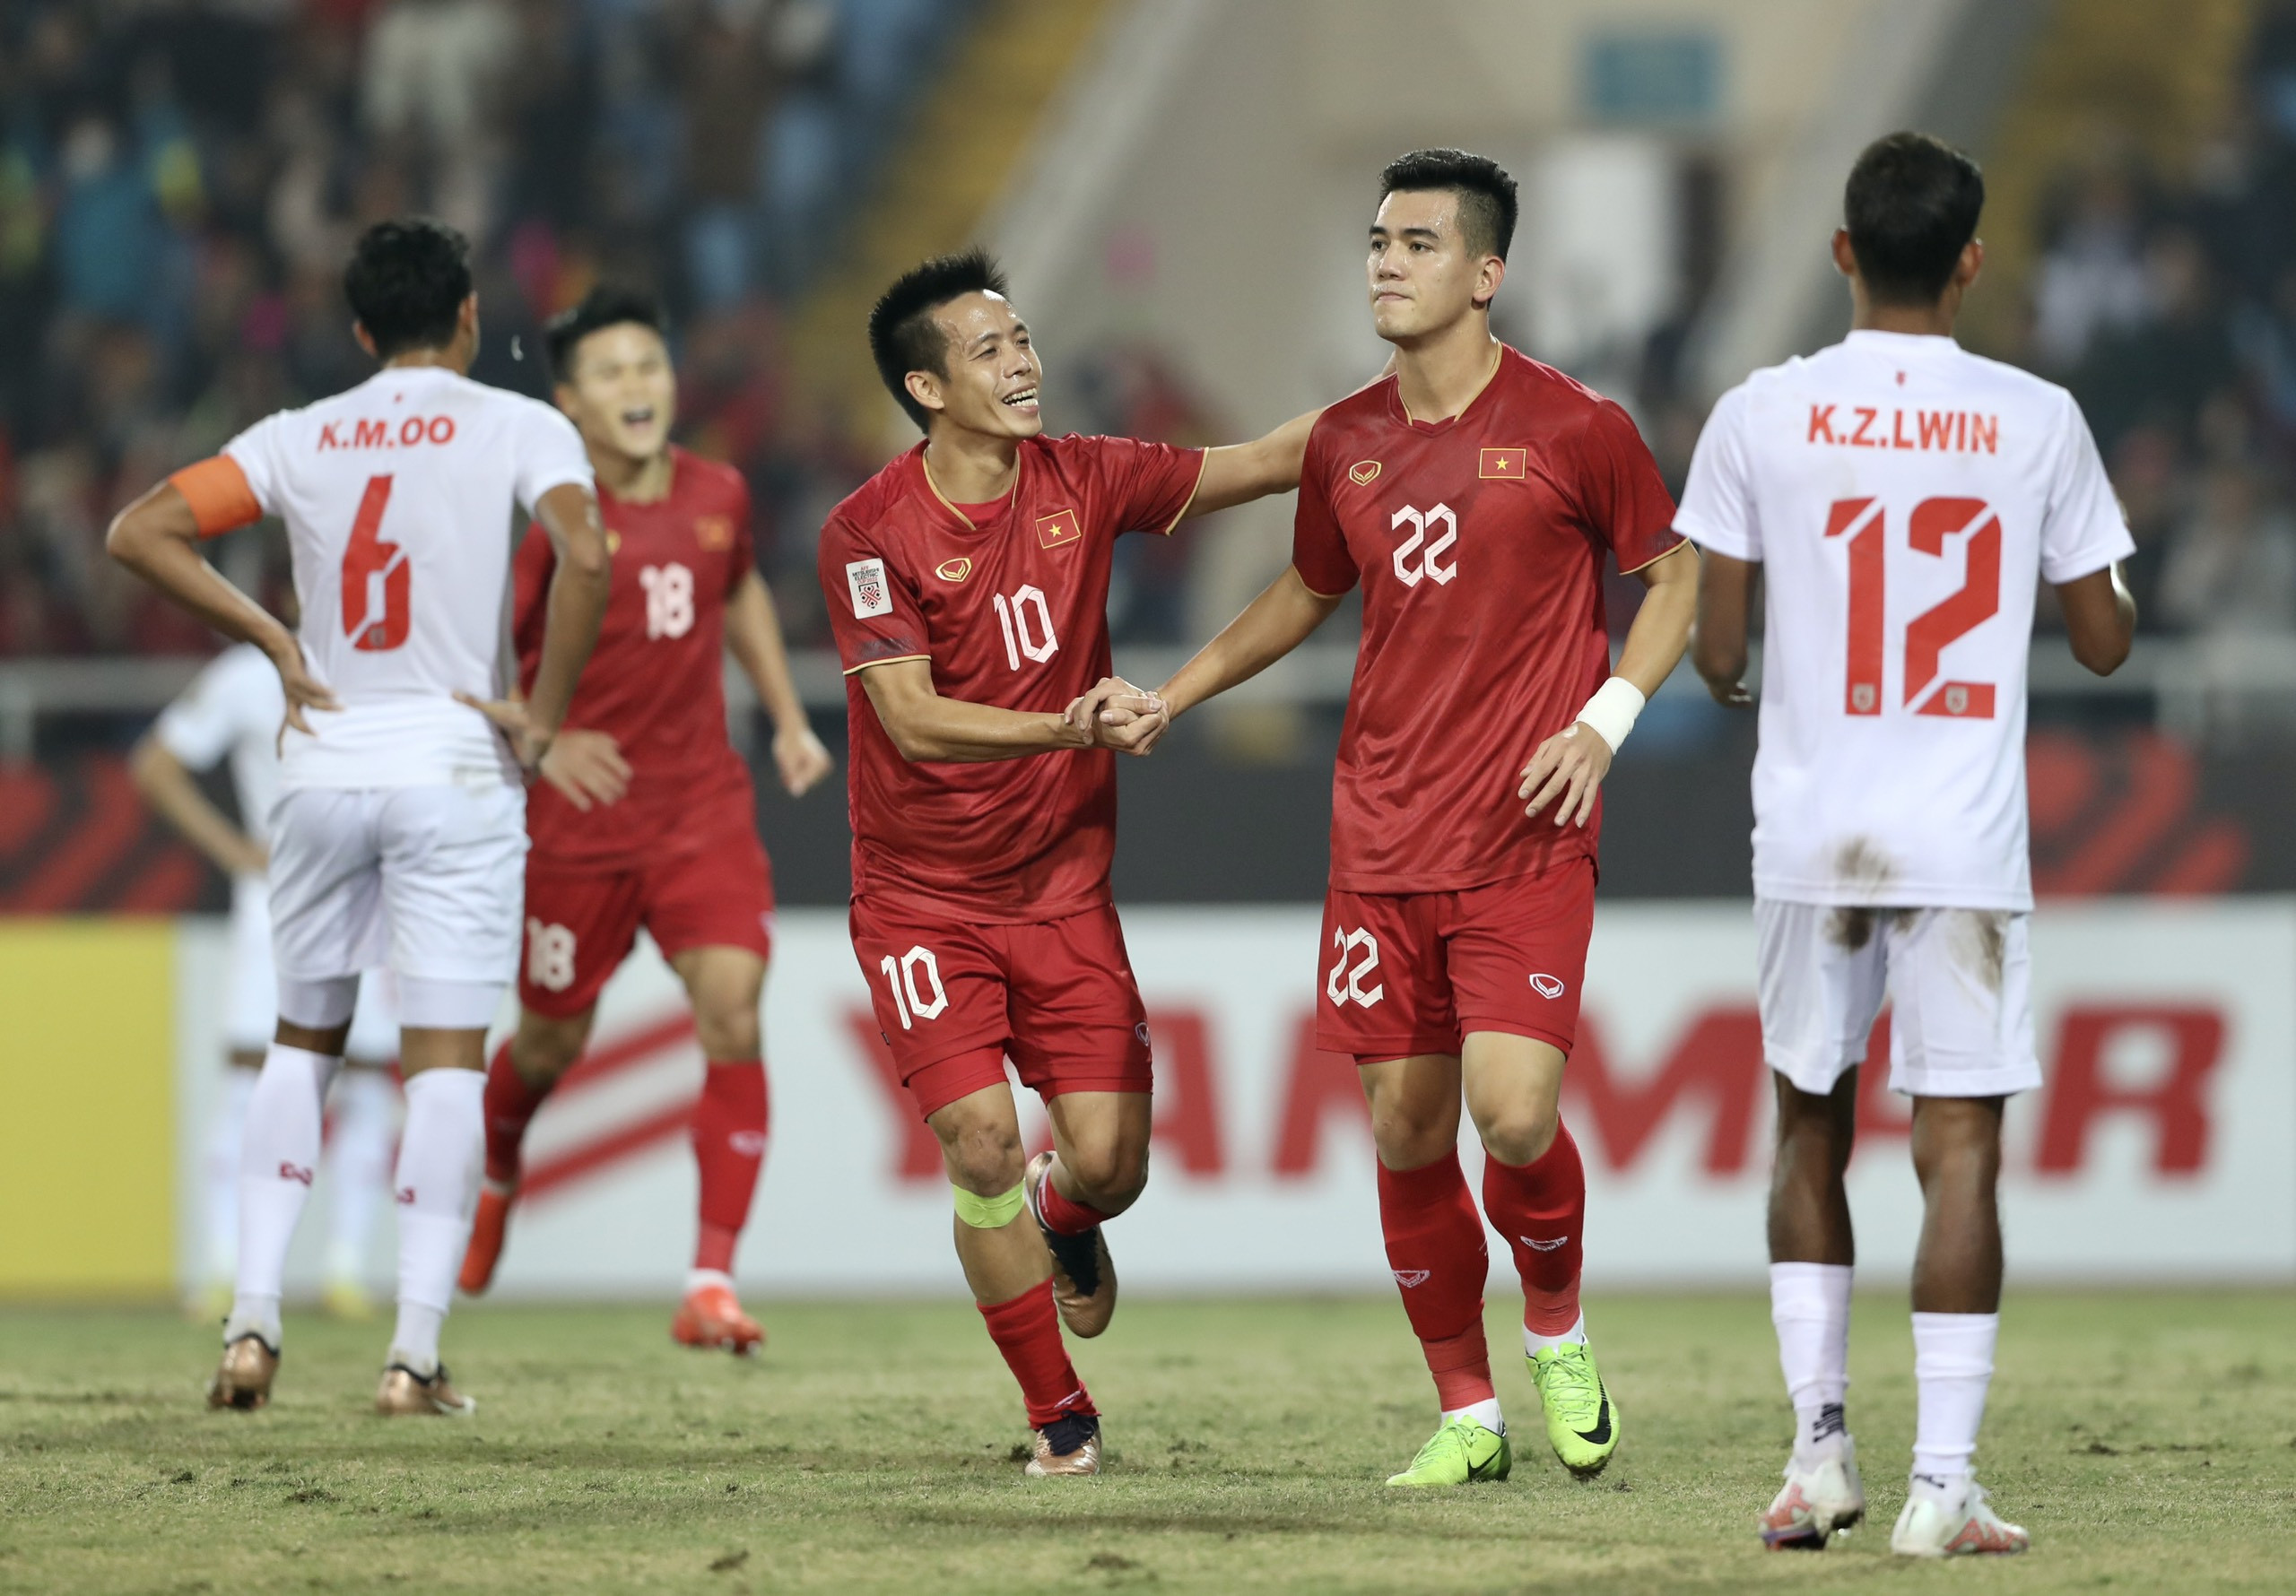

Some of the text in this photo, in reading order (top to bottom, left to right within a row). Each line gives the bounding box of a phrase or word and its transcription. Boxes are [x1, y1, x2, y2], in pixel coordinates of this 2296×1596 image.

[318, 415, 456, 452] K.M.OO
[1806, 404, 1998, 455] K.Z.LWIN
[341, 473, 411, 652] 6
[1391, 502, 1457, 587] 22
[639, 561, 695, 640] 18
[993, 584, 1059, 672] 10
[1823, 496, 2003, 719] 12
[526, 915, 577, 993] 18
[880, 944, 949, 1030] 10
[1326, 924, 1384, 1009] 22
[845, 1006, 2230, 1178] YAMR
